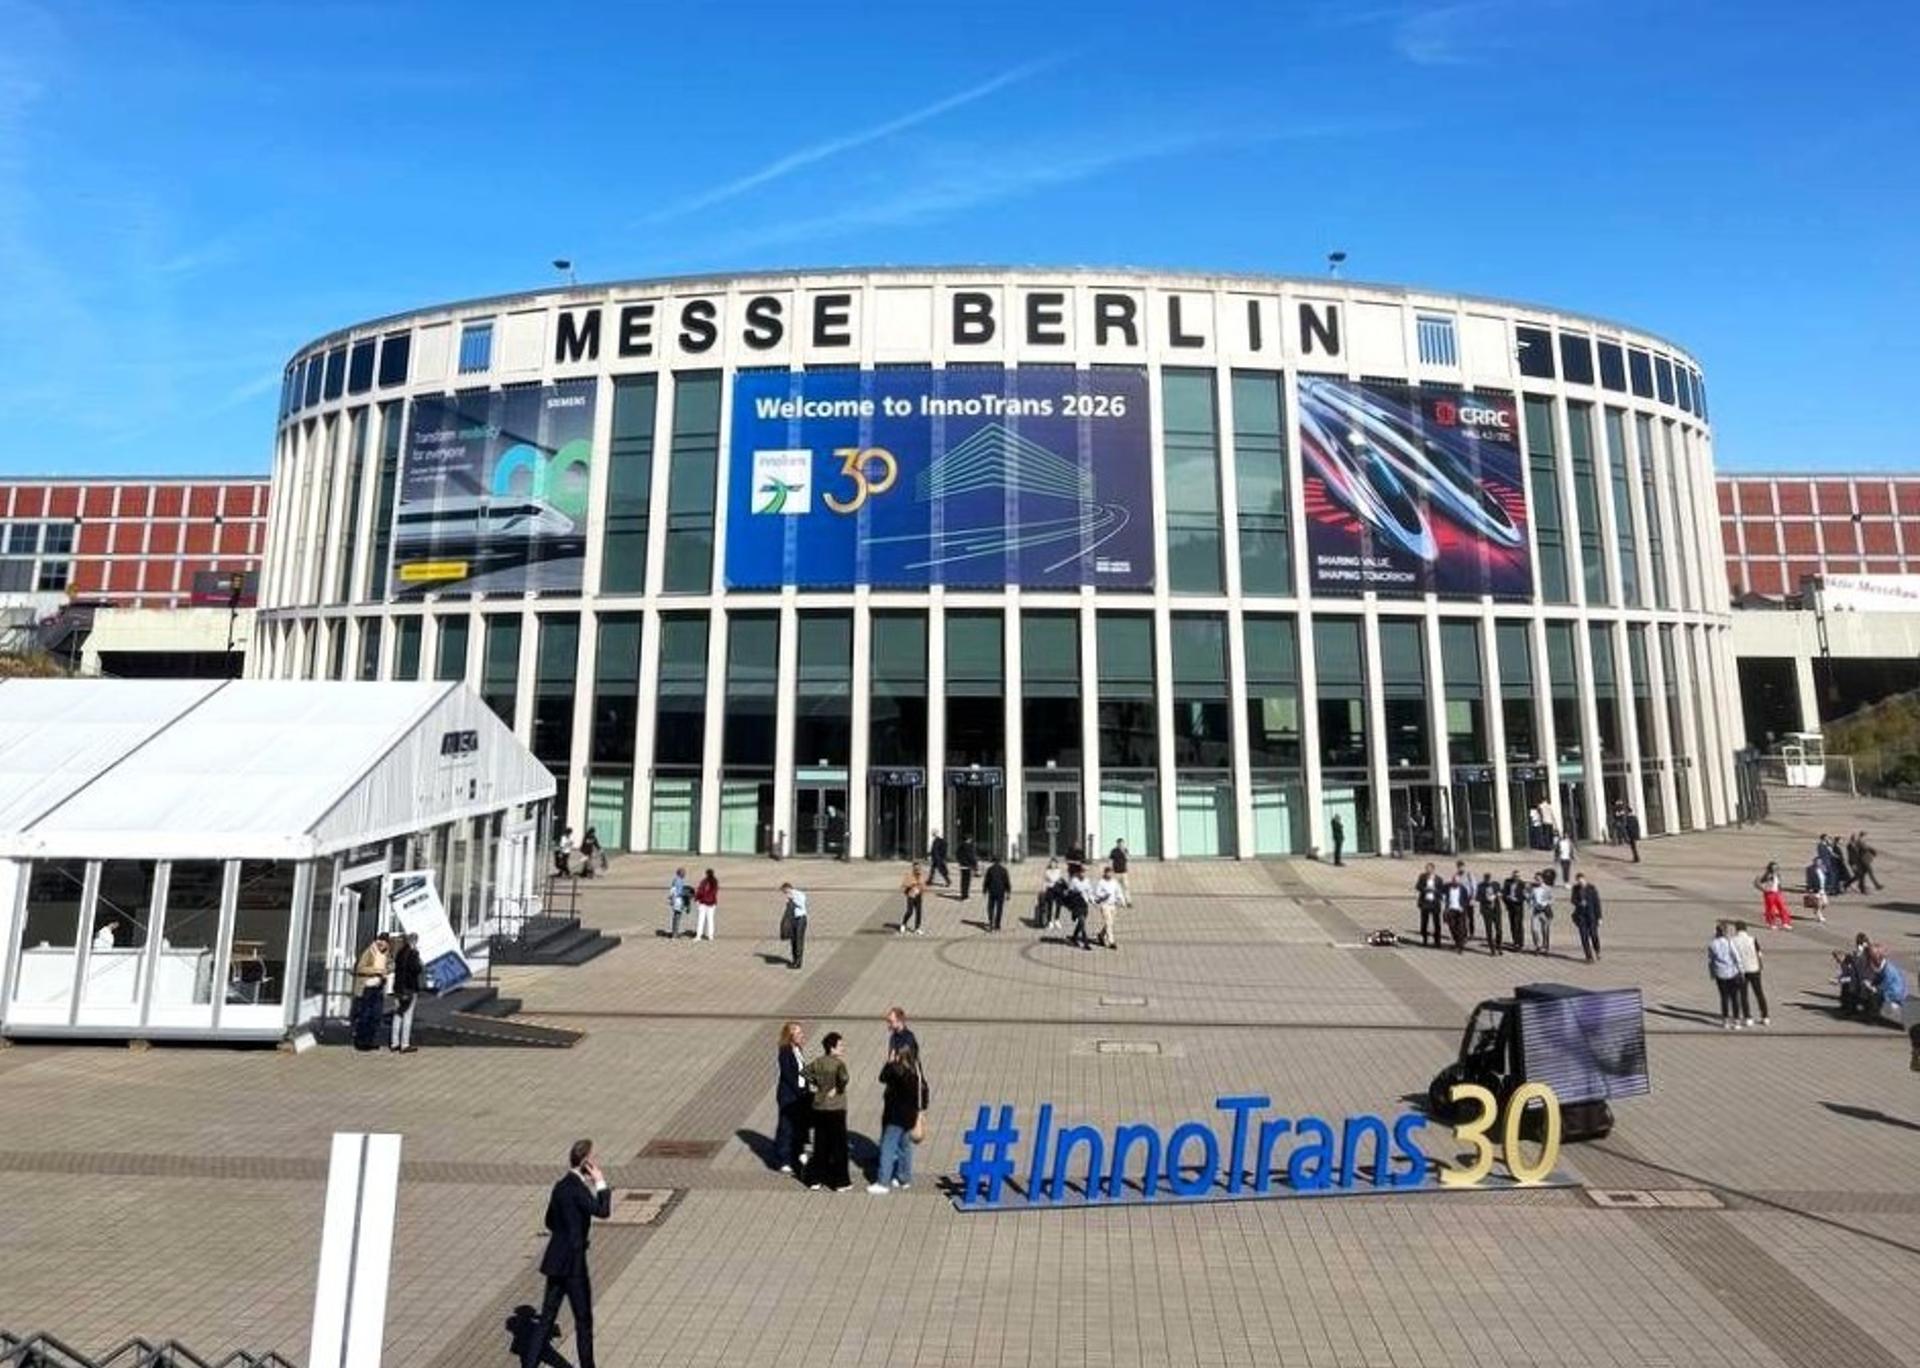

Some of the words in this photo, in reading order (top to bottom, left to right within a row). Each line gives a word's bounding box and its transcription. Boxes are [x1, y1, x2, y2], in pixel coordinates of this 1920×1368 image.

[555, 294, 852, 364] MESSE
[952, 292, 1341, 357] BERLIN
[755, 395, 875, 419] Welcome
[882, 395, 912, 416] to
[920, 394, 1053, 416] InnoTrans
[1061, 395, 1126, 417] 2026
[1459, 407, 1511, 428] CRRC
[822, 447, 898, 514] 30
